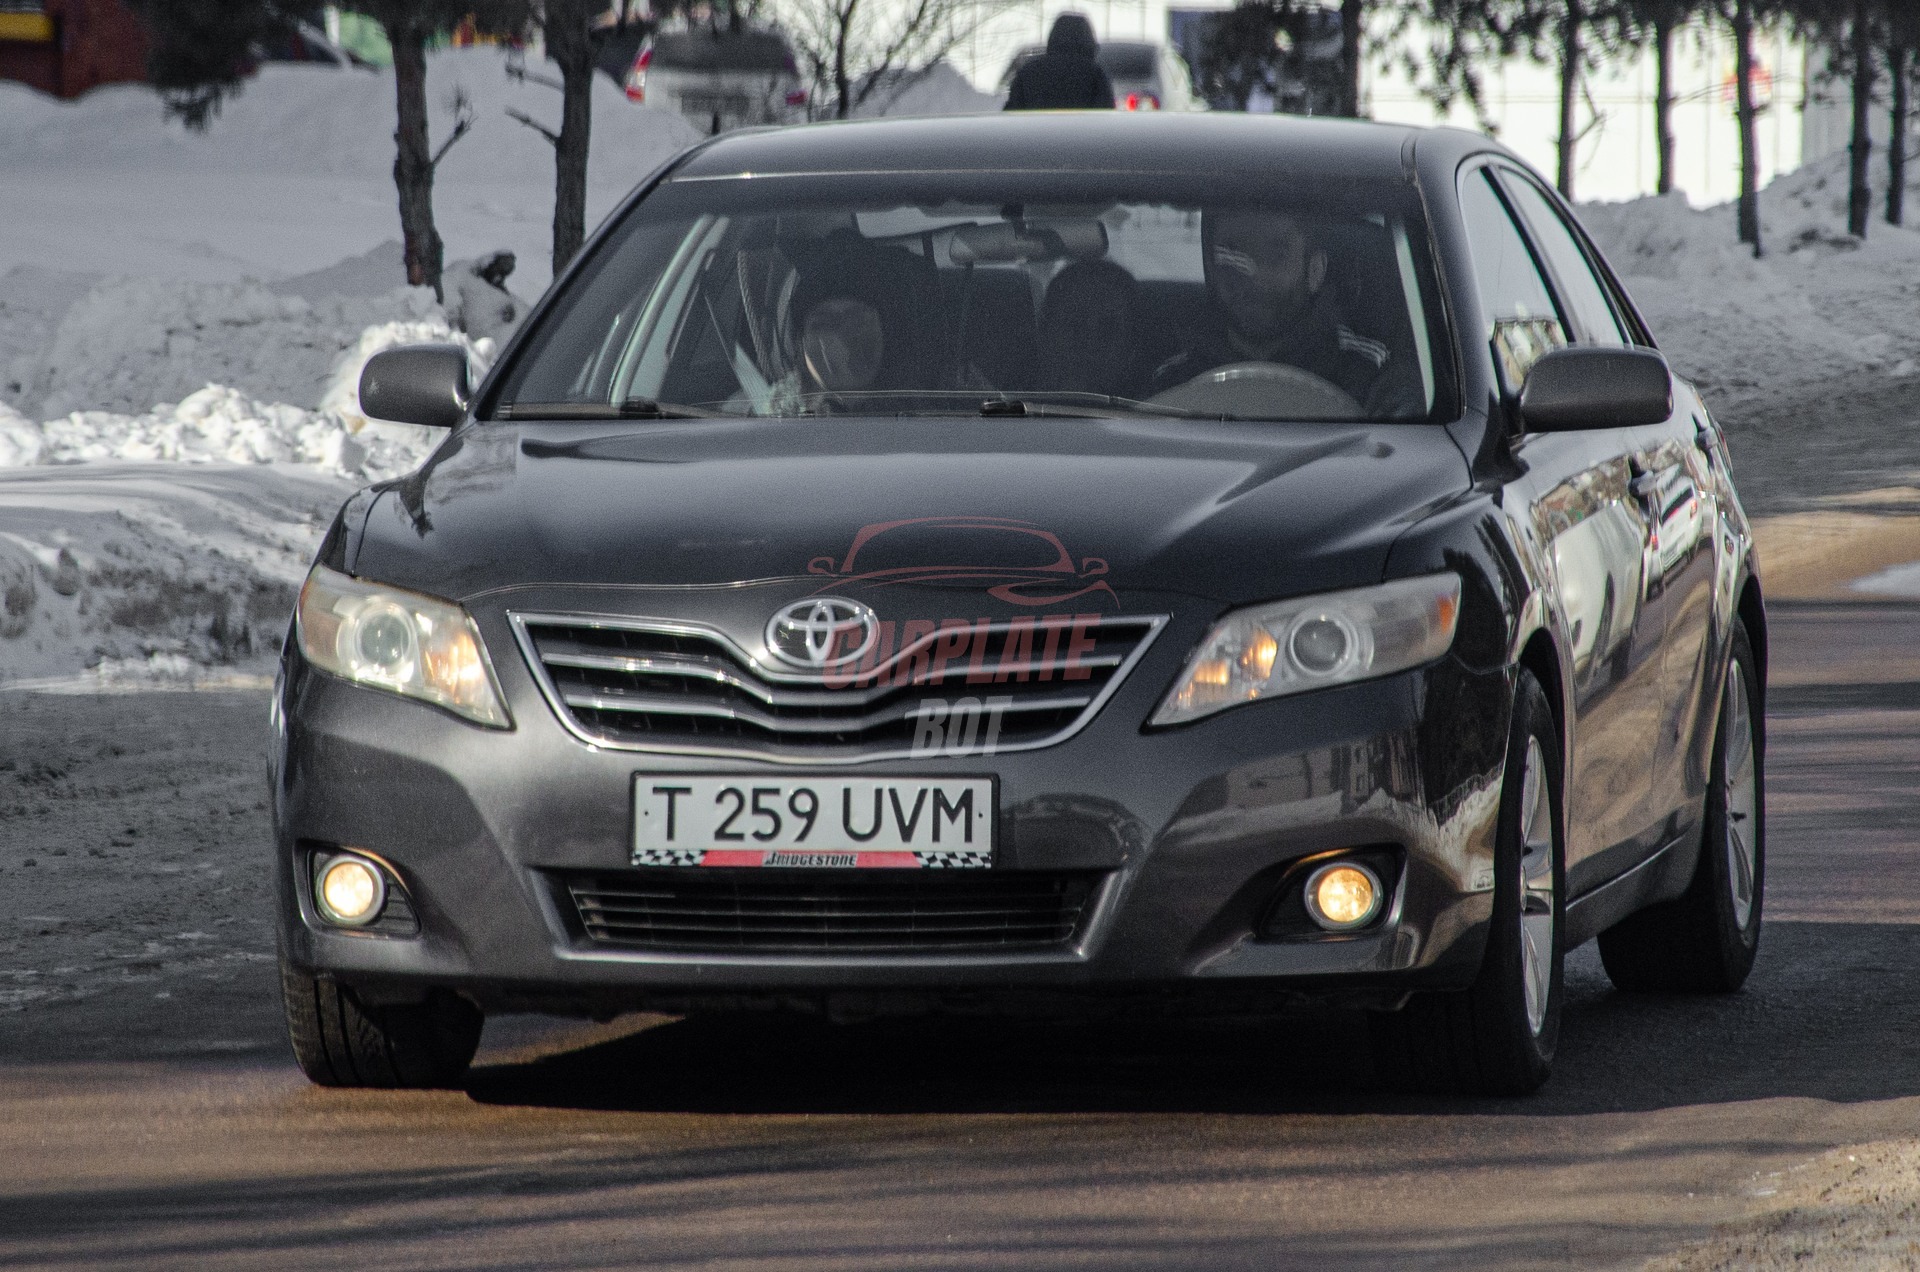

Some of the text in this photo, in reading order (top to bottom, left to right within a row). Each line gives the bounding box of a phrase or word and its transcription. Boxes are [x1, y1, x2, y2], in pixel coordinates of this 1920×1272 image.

[652, 786, 974, 843] T 259 UVM
[764, 851, 857, 867] BRIDGESTONE
